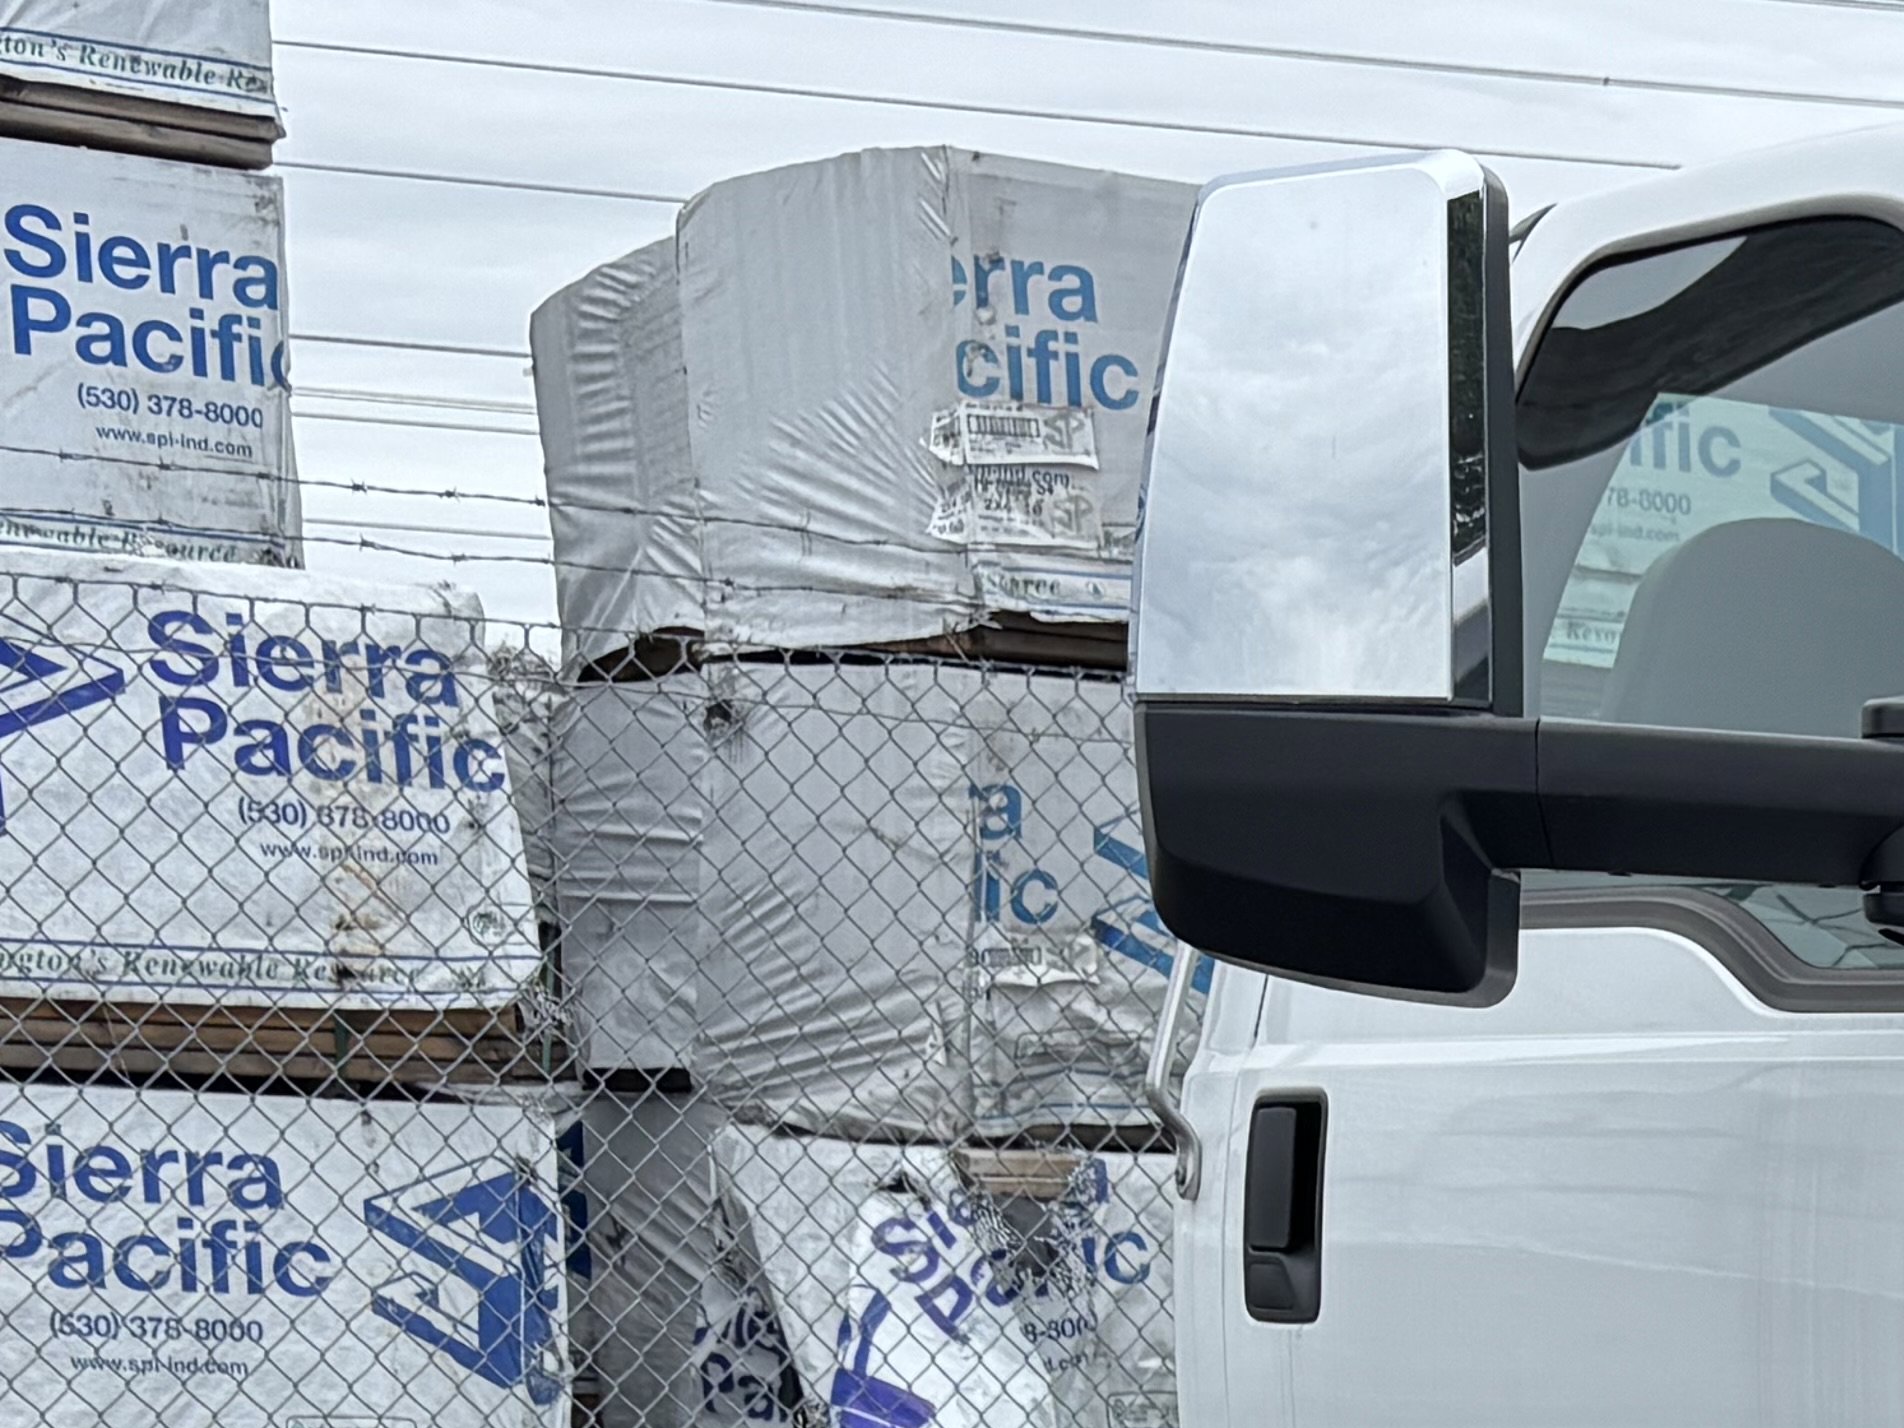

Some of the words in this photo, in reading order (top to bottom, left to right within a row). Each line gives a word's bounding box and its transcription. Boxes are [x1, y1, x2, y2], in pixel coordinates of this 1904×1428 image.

[79, 44, 218, 87] Renewable
[4, 204, 278, 311] Sierra
[77, 382, 140, 413] (530)
[147, 394, 263, 430] 378-8000
[147, 609, 460, 708] Sierra
[158, 695, 506, 793] Pacific
[238, 797, 308, 829] (530)
[316, 804, 452, 836] 378-8000
[49, 1310, 120, 1341] (530)
[130, 1317, 264, 1344] 378-8000
